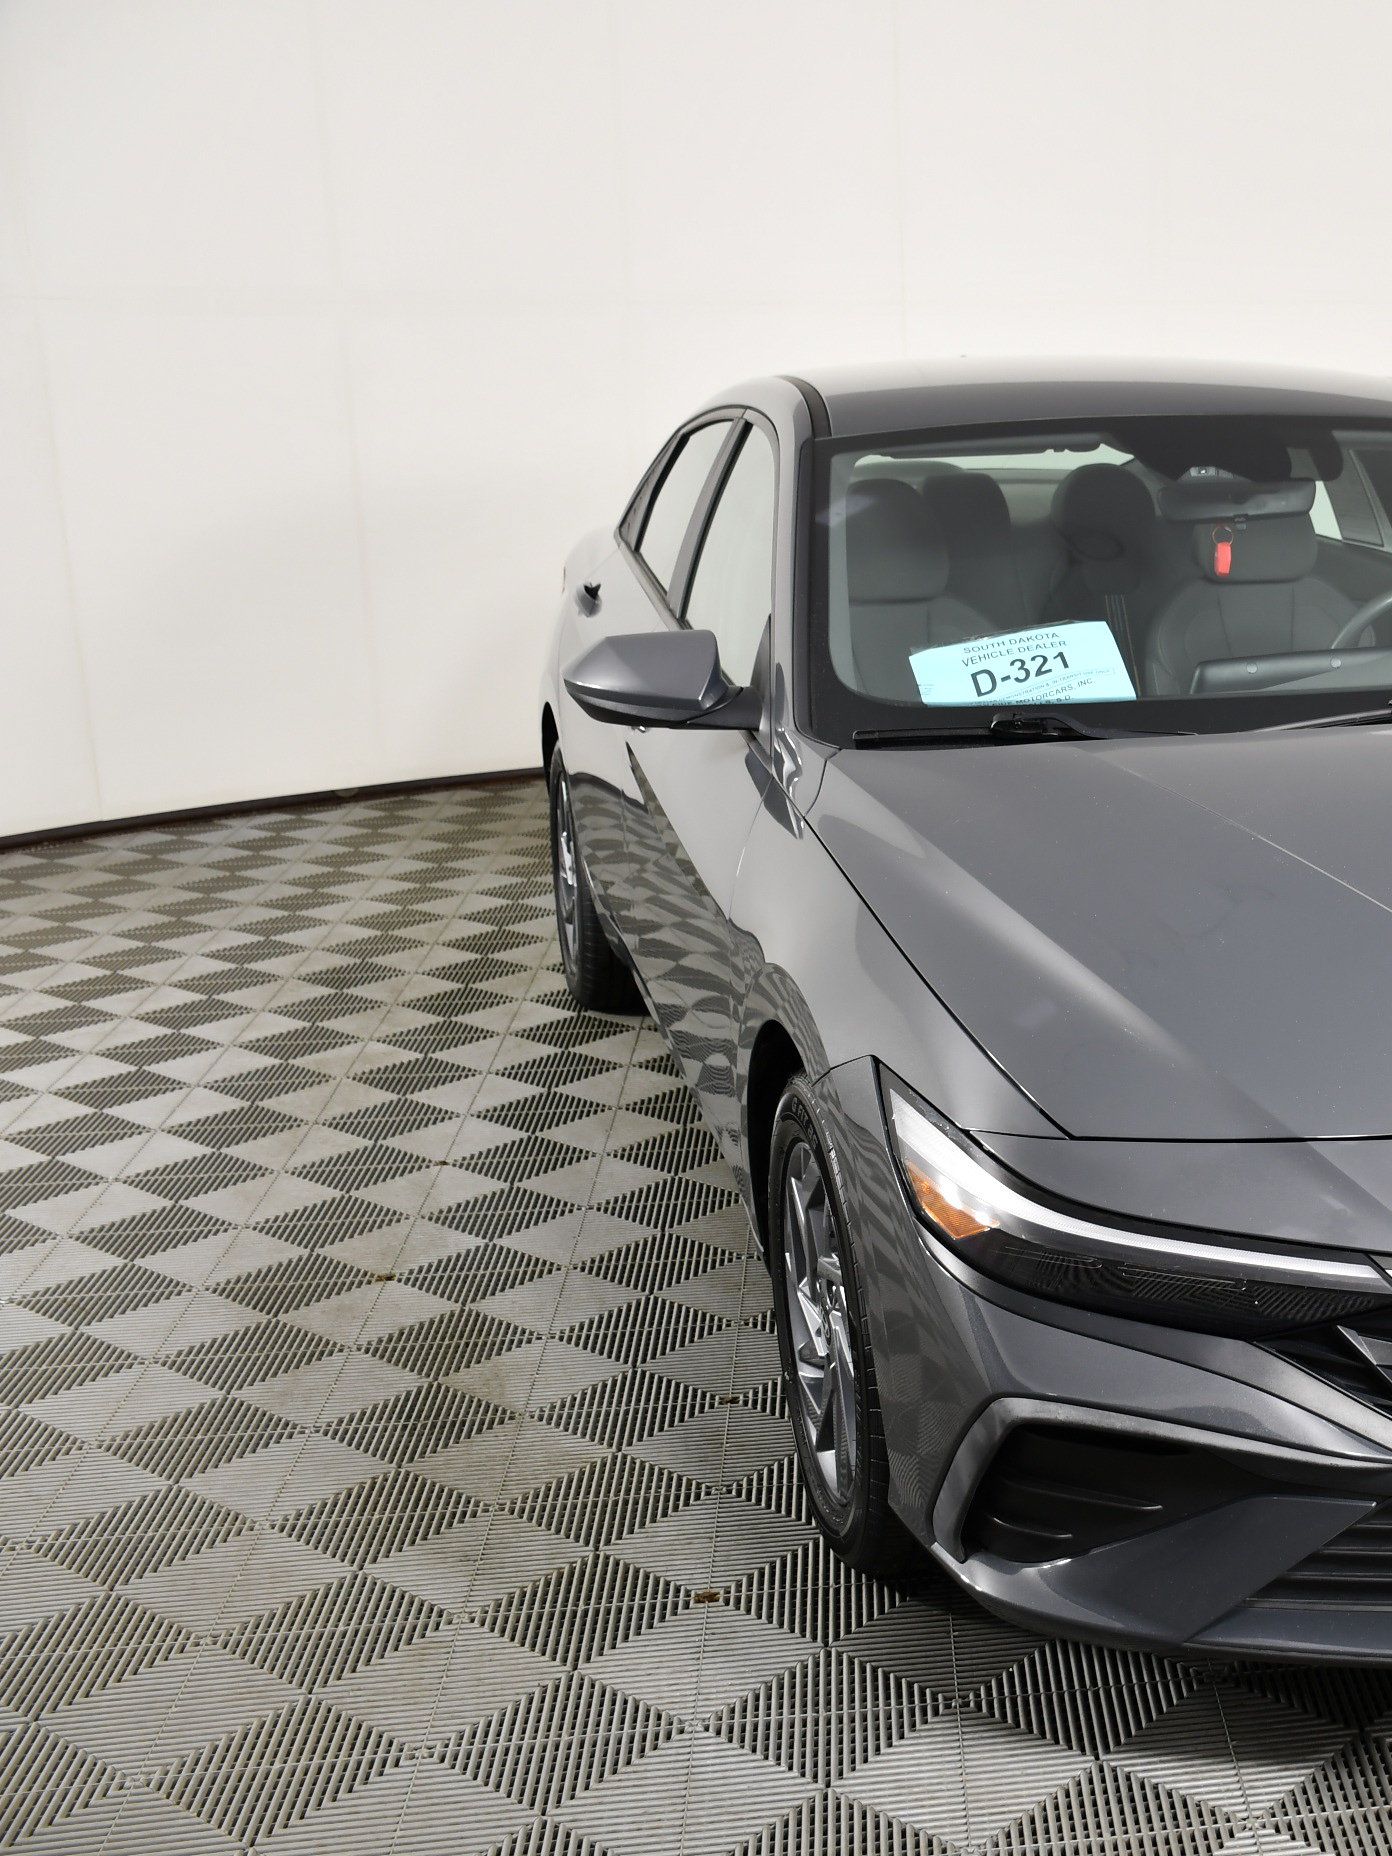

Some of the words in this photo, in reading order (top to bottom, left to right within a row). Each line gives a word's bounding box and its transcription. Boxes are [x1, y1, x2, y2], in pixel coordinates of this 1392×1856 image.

[961, 648, 1015, 667] VEHICLE
[1018, 640, 1067, 653] DEALER
[963, 641, 1006, 654] SOUTH
[1009, 632, 1060, 646] DAKOTA
[970, 651, 1069, 698] D-321
[1077, 677, 1096, 688] INC.
